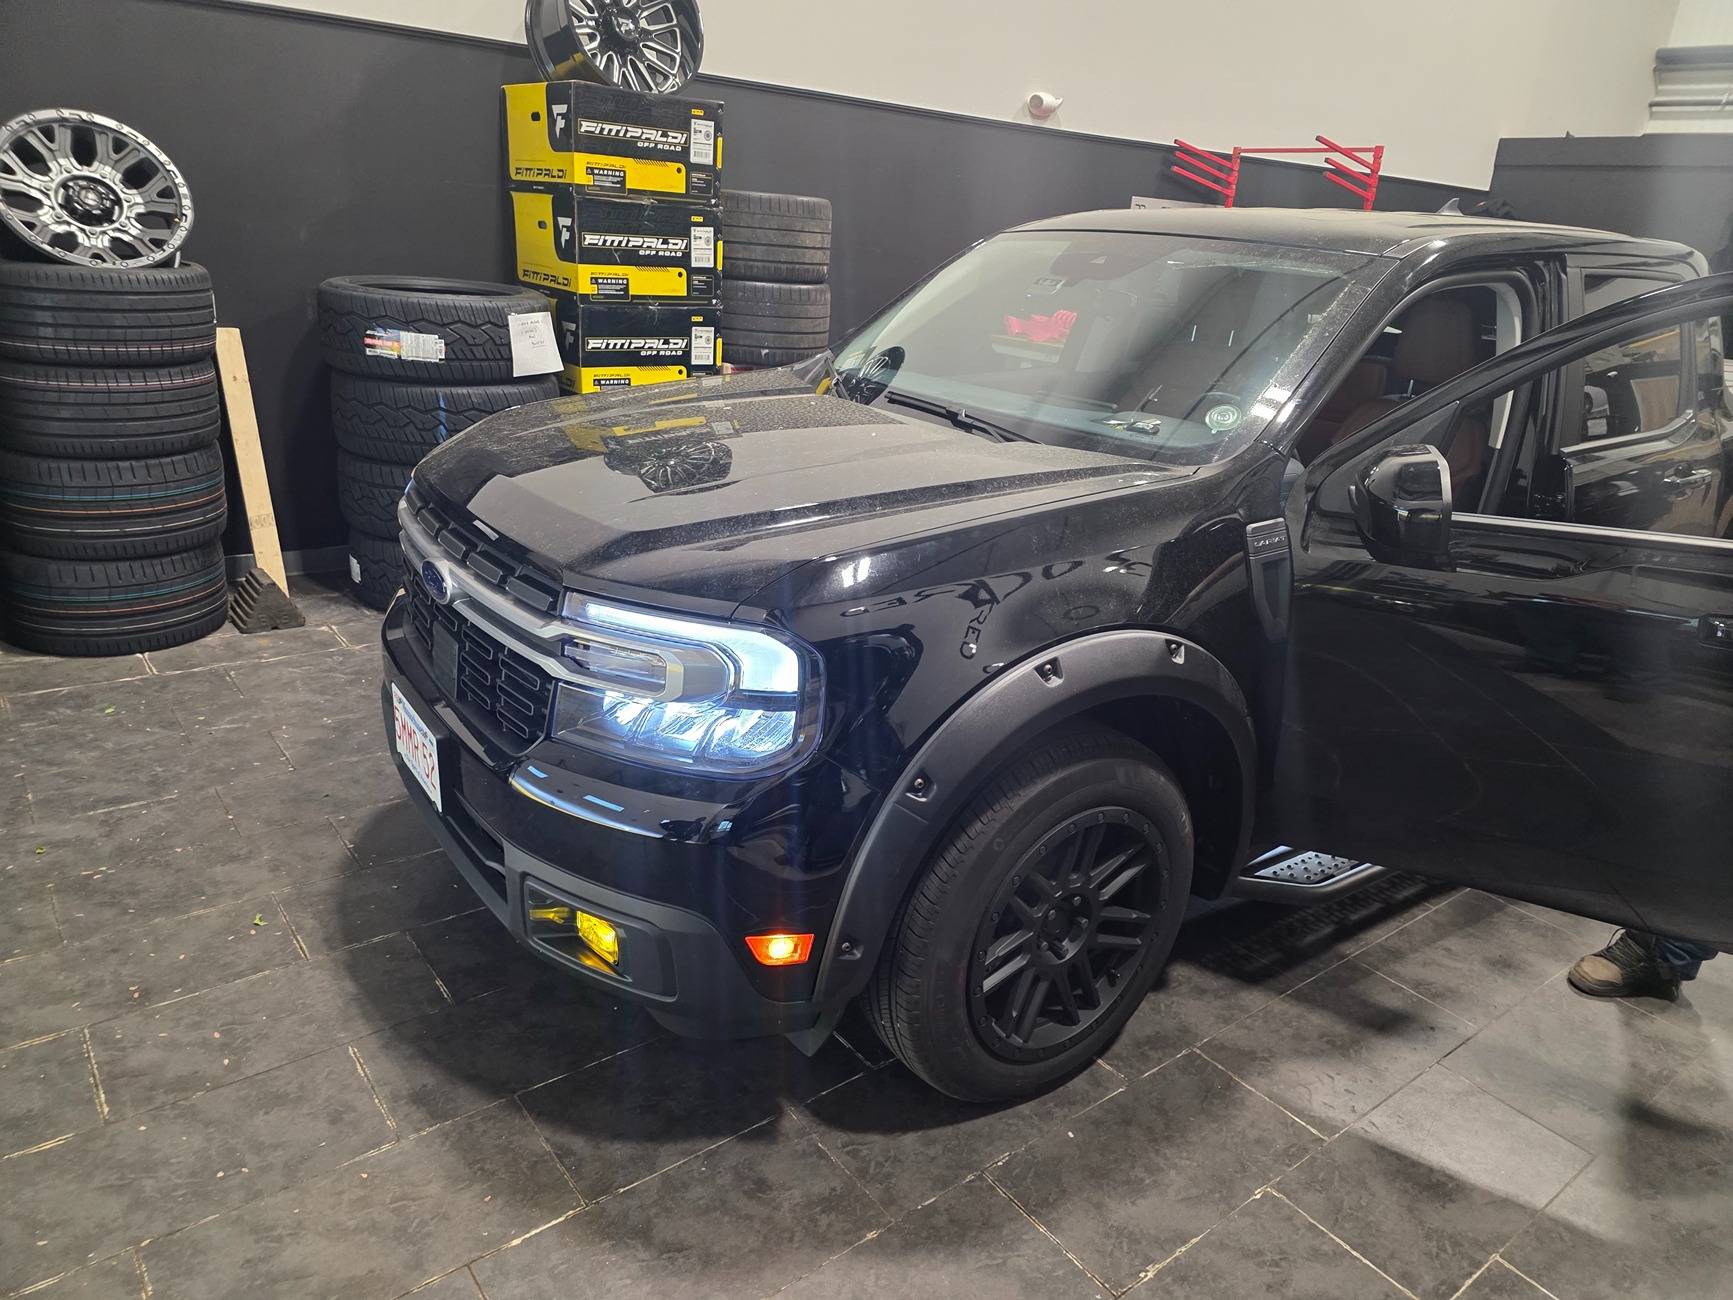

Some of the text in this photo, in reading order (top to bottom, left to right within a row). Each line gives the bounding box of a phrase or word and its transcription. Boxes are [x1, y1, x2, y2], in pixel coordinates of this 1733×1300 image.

[580, 121, 689, 144] FITTIPALDI
[637, 141, 682, 151] OFF ROAD
[514, 167, 568, 180] FITTIPALDI
[593, 168, 624, 177] WARNING
[583, 234, 688, 250] FITTIPALDI
[522, 269, 571, 288] FITTIPALDI
[587, 338, 688, 350] FITTIPALDI
